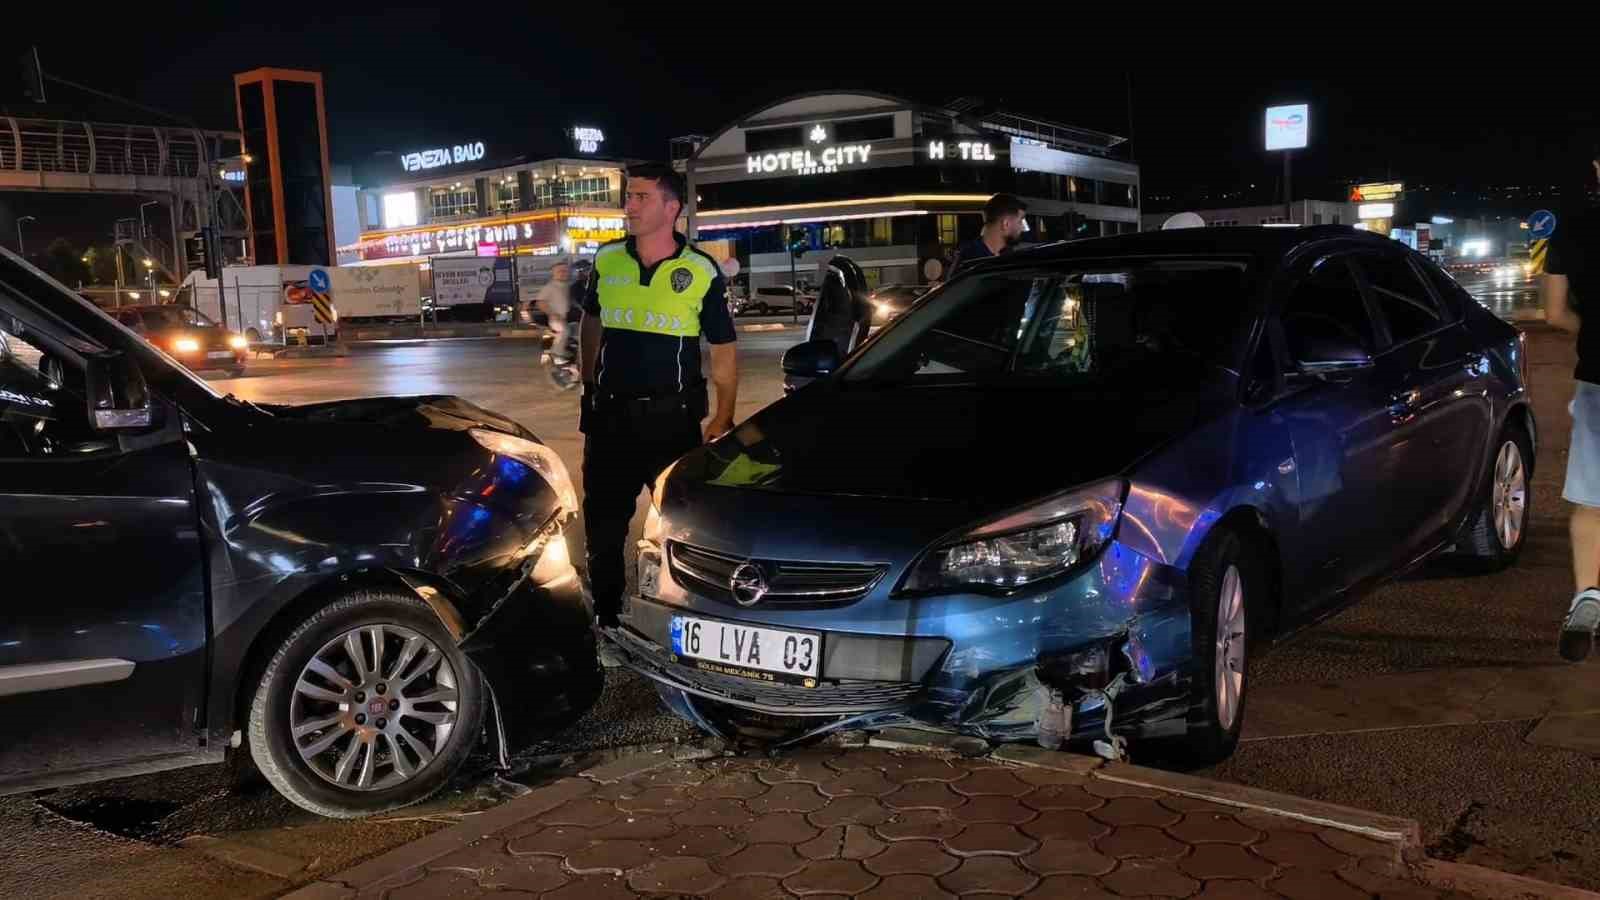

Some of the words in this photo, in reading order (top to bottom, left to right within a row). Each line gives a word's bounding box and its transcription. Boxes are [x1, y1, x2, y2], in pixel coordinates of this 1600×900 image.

[401, 149, 452, 172] VENEZIA
[454, 141, 485, 163] BALO
[747, 149, 817, 174] HOTEL
[822, 144, 872, 167] CITY
[684, 621, 702, 655] 16
[719, 626, 761, 666] LVA
[783, 635, 814, 673] 03
